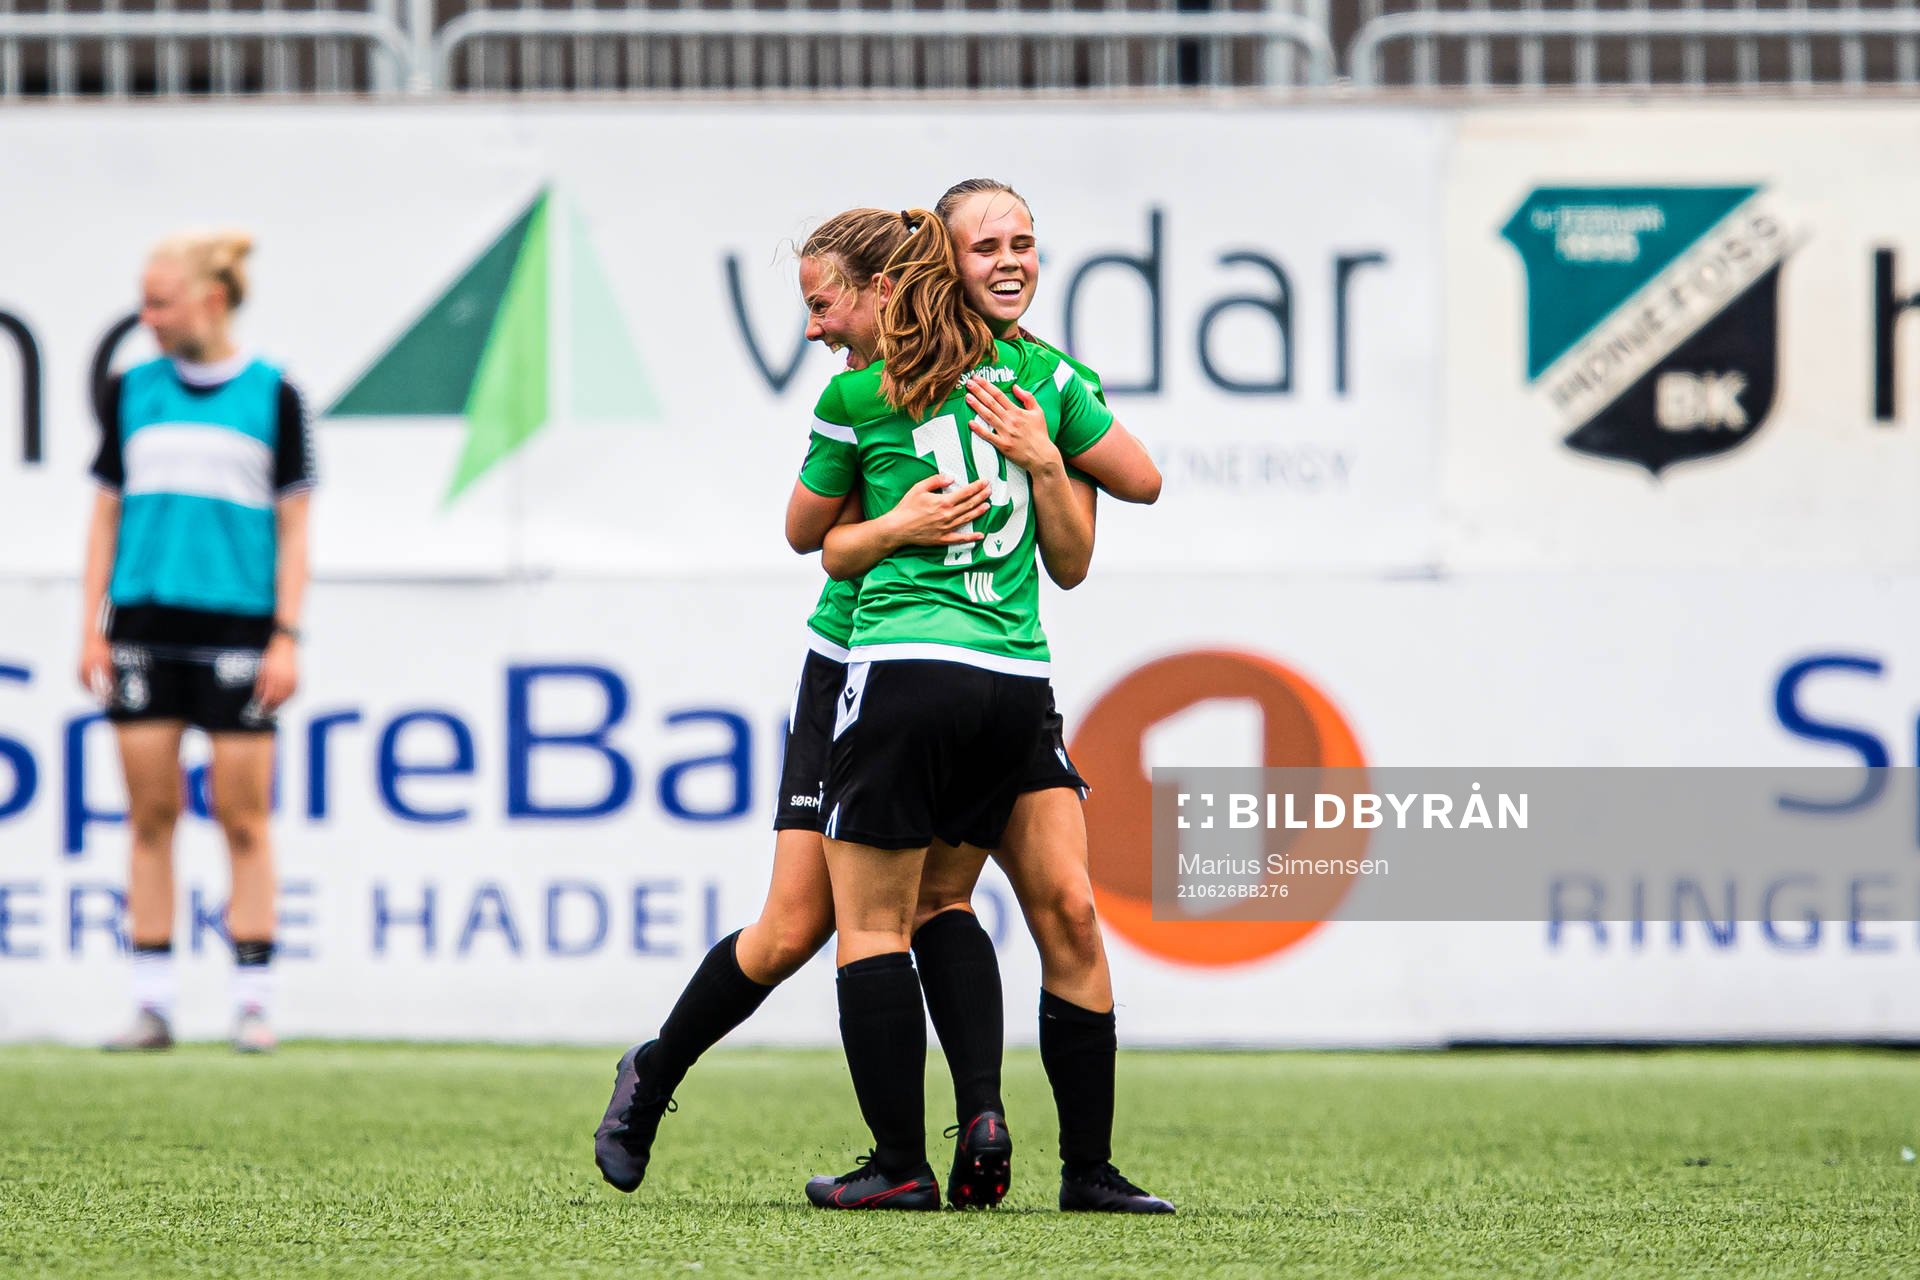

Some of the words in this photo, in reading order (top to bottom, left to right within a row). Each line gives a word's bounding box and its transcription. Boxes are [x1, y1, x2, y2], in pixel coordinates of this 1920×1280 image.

[1656, 372, 1748, 431] BK
[911, 413, 1030, 566] 19
[963, 571, 1003, 604] VIK
[0, 882, 314, 956] ERKE
[1546, 872, 1920, 954] RINGE
